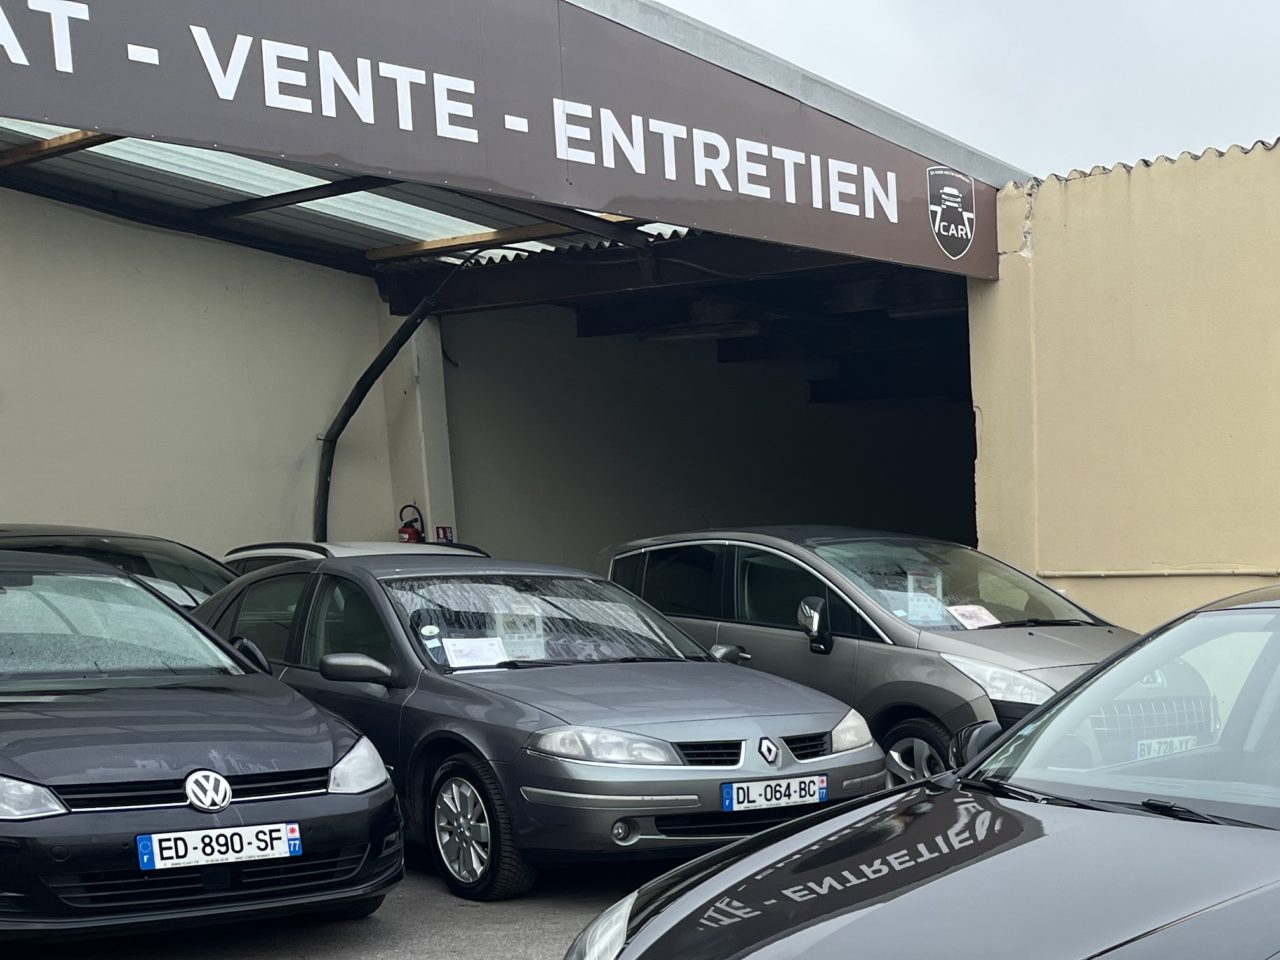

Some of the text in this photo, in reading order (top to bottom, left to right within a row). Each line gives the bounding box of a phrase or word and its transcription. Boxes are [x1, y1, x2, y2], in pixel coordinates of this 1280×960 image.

[127, 43, 160, 65] -
[189, 24, 479, 144] VENTE
[504, 114, 529, 133] -
[552, 97, 899, 224] ENTRETIEN
[736, 780, 816, 805] DL-064-BC
[158, 828, 283, 861] ED-890-SF
[289, 840, 299, 851] 77
[143, 855, 149, 863] F
